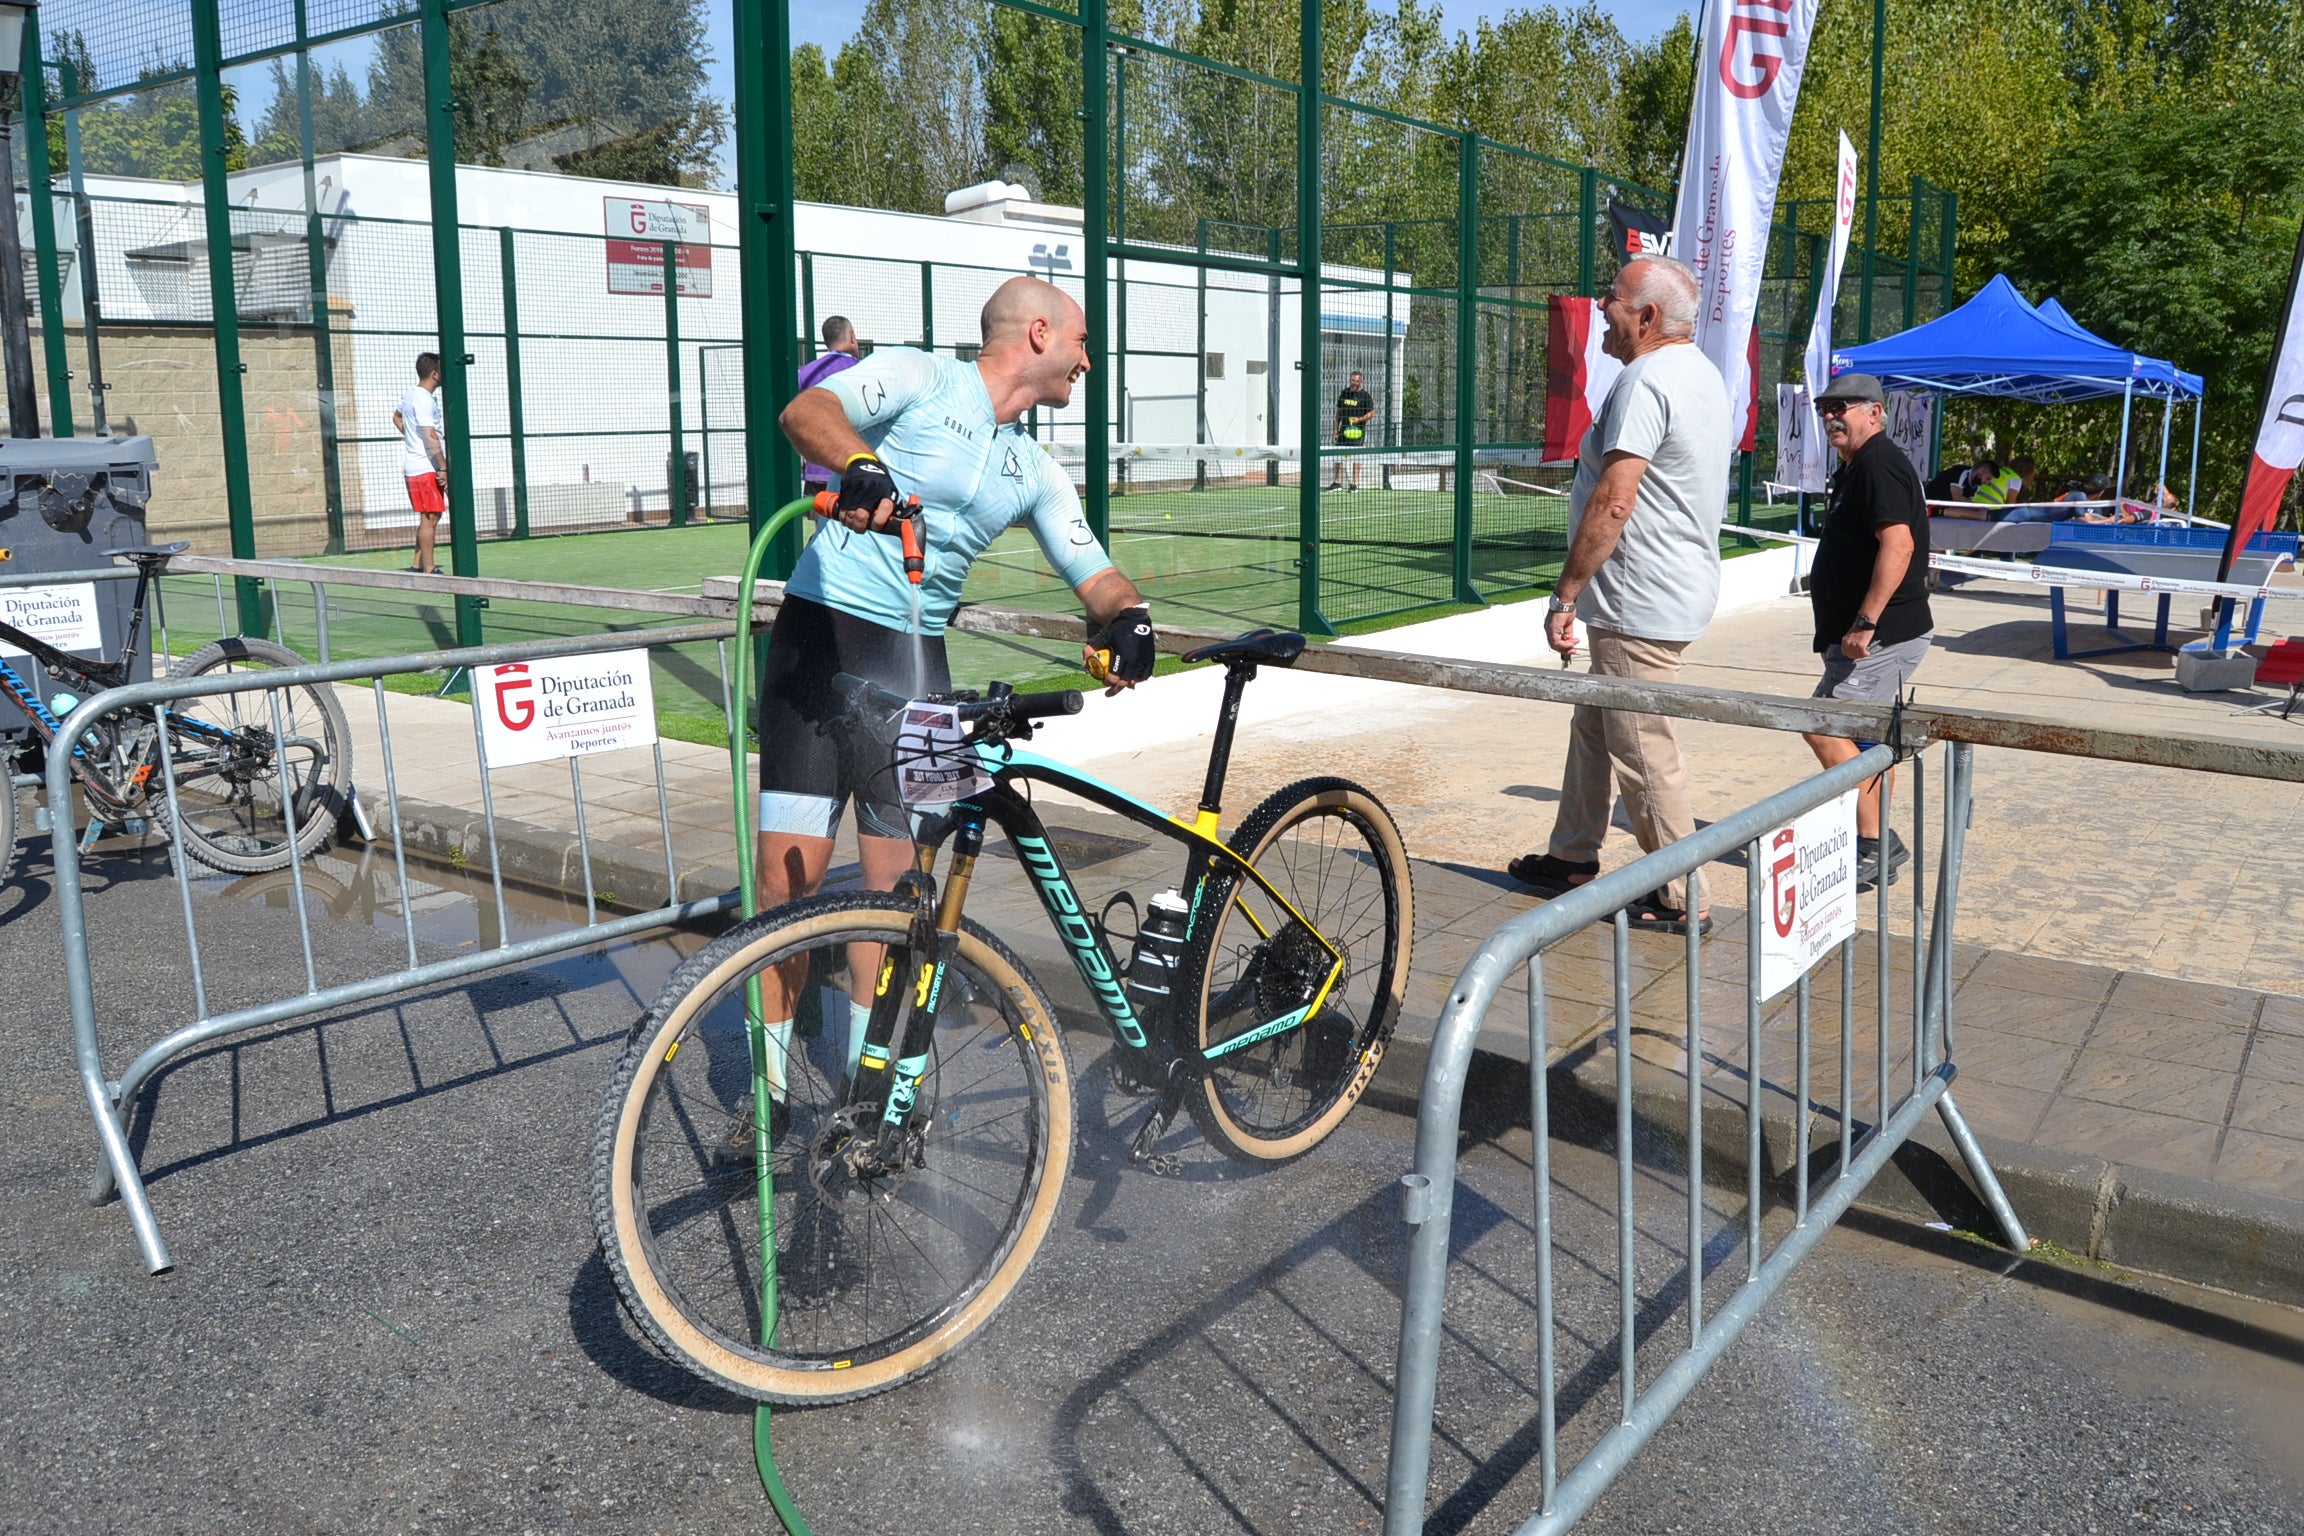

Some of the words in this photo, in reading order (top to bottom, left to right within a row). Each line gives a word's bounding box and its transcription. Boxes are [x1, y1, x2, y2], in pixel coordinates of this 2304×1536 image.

[1695, 155, 1721, 245] Granada
[657, 223, 687, 234] Granada
[1712, 229, 1737, 323] Deportes
[944, 415, 973, 441] GOBIK
[5, 596, 81, 614] Diputación
[8, 615, 24, 628] de
[26, 610, 83, 627] Granada
[540, 669, 633, 697] Diputación
[543, 700, 564, 718] de
[566, 691, 636, 716] Granada
[546, 728, 600, 741] Avanzamos
[601, 722, 632, 736] junt@s
[570, 736, 618, 751] Deportes
[1799, 826, 1848, 876] Diputación
[1799, 881, 1809, 911] de
[1809, 858, 1848, 902] Granada
[1809, 931, 1832, 957] Deportes
[926, 974, 942, 1015] FACTORY
[1008, 985, 1061, 1084] MAXXIS
[1347, 1024, 1389, 1102] MAXXIS
[884, 1073, 916, 1127] FOX
